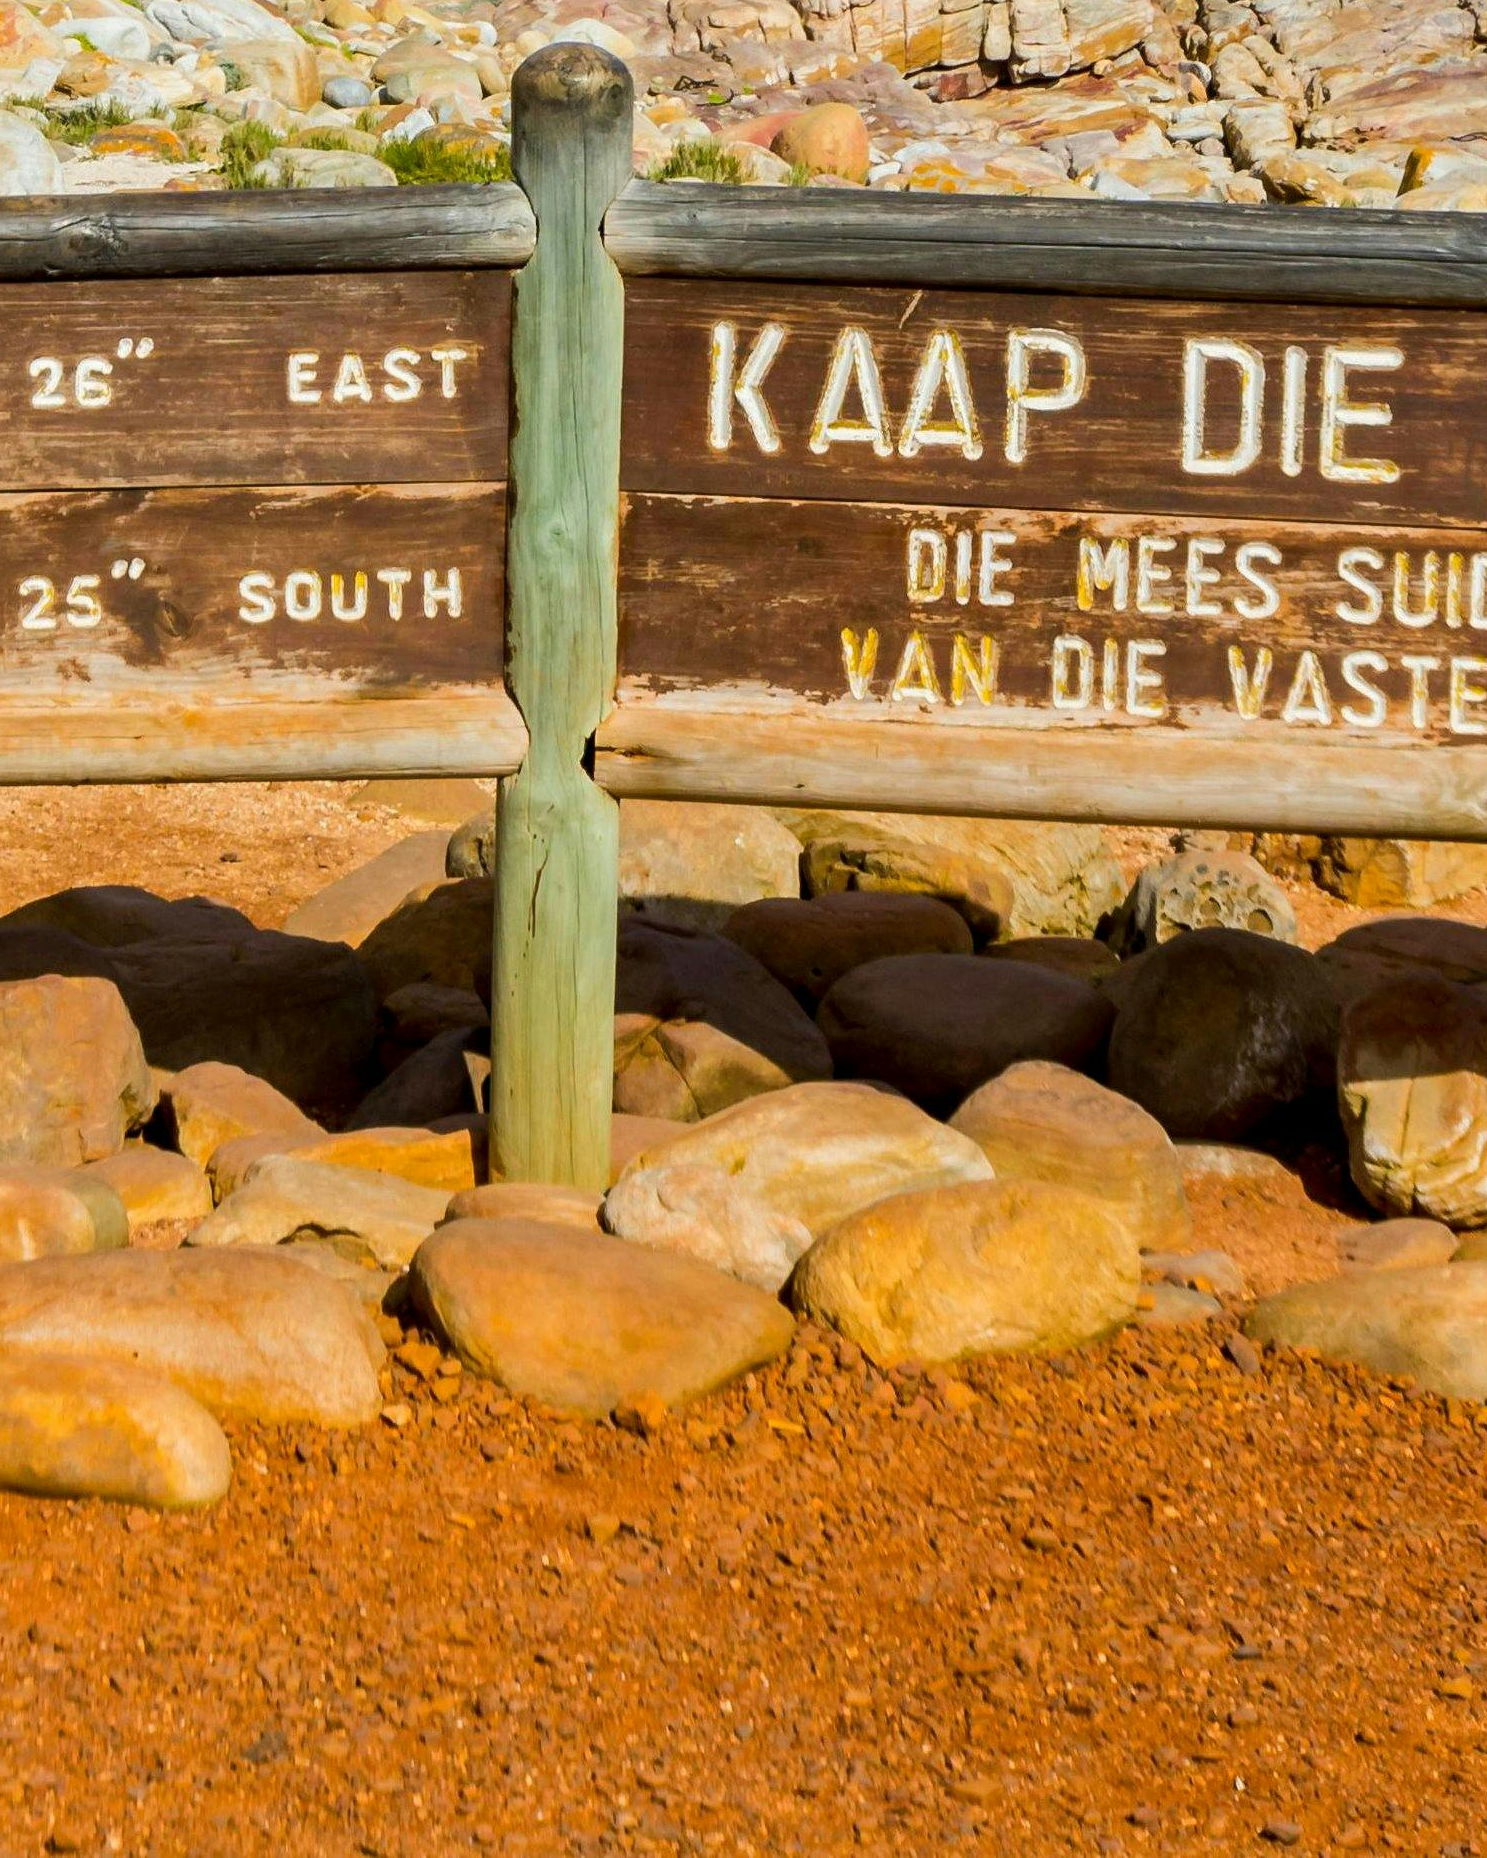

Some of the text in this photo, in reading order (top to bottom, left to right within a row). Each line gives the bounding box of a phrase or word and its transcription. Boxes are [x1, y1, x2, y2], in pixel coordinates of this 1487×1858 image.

[287, 346, 469, 404] EAST
[708, 320, 1088, 465] KAAP
[1181, 338, 1406, 485] DIE
[237, 567, 464, 624] SOUTH
[906, 528, 1018, 607] DIE
[1077, 536, 1283, 620] MEES
[839, 626, 999, 707] VAN
[1050, 635, 1169, 720] DIE
